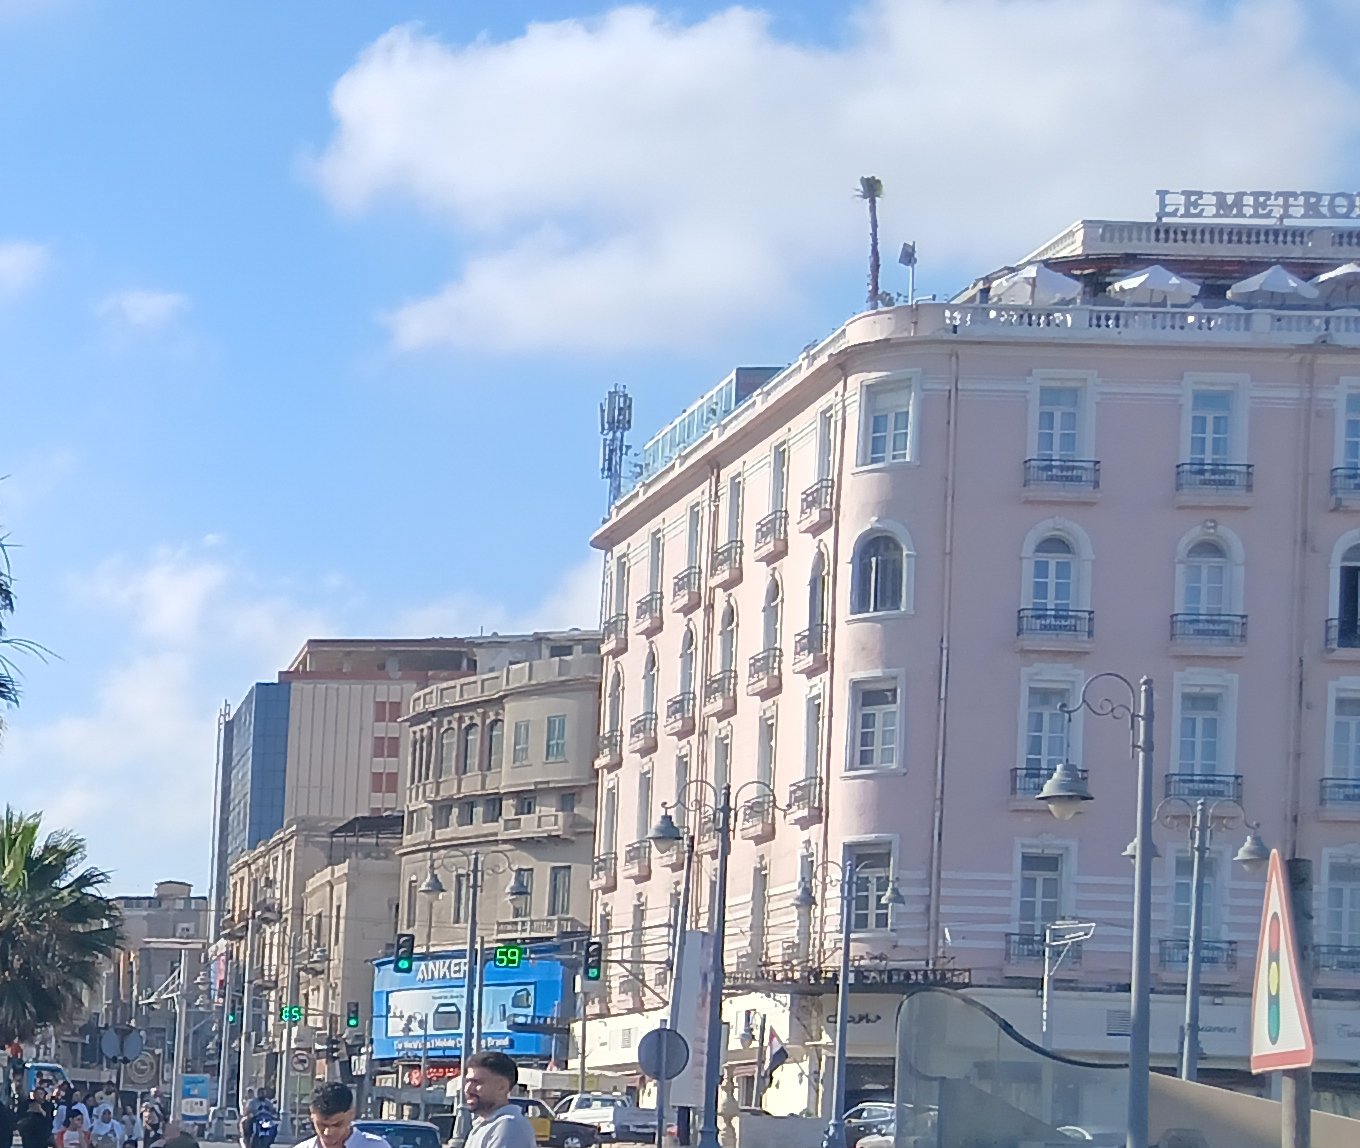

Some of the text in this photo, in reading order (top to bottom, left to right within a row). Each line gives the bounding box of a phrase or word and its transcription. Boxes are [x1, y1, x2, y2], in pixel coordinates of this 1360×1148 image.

[1156, 189, 1360, 219] LE METRO
[496, 948, 519, 967] 59
